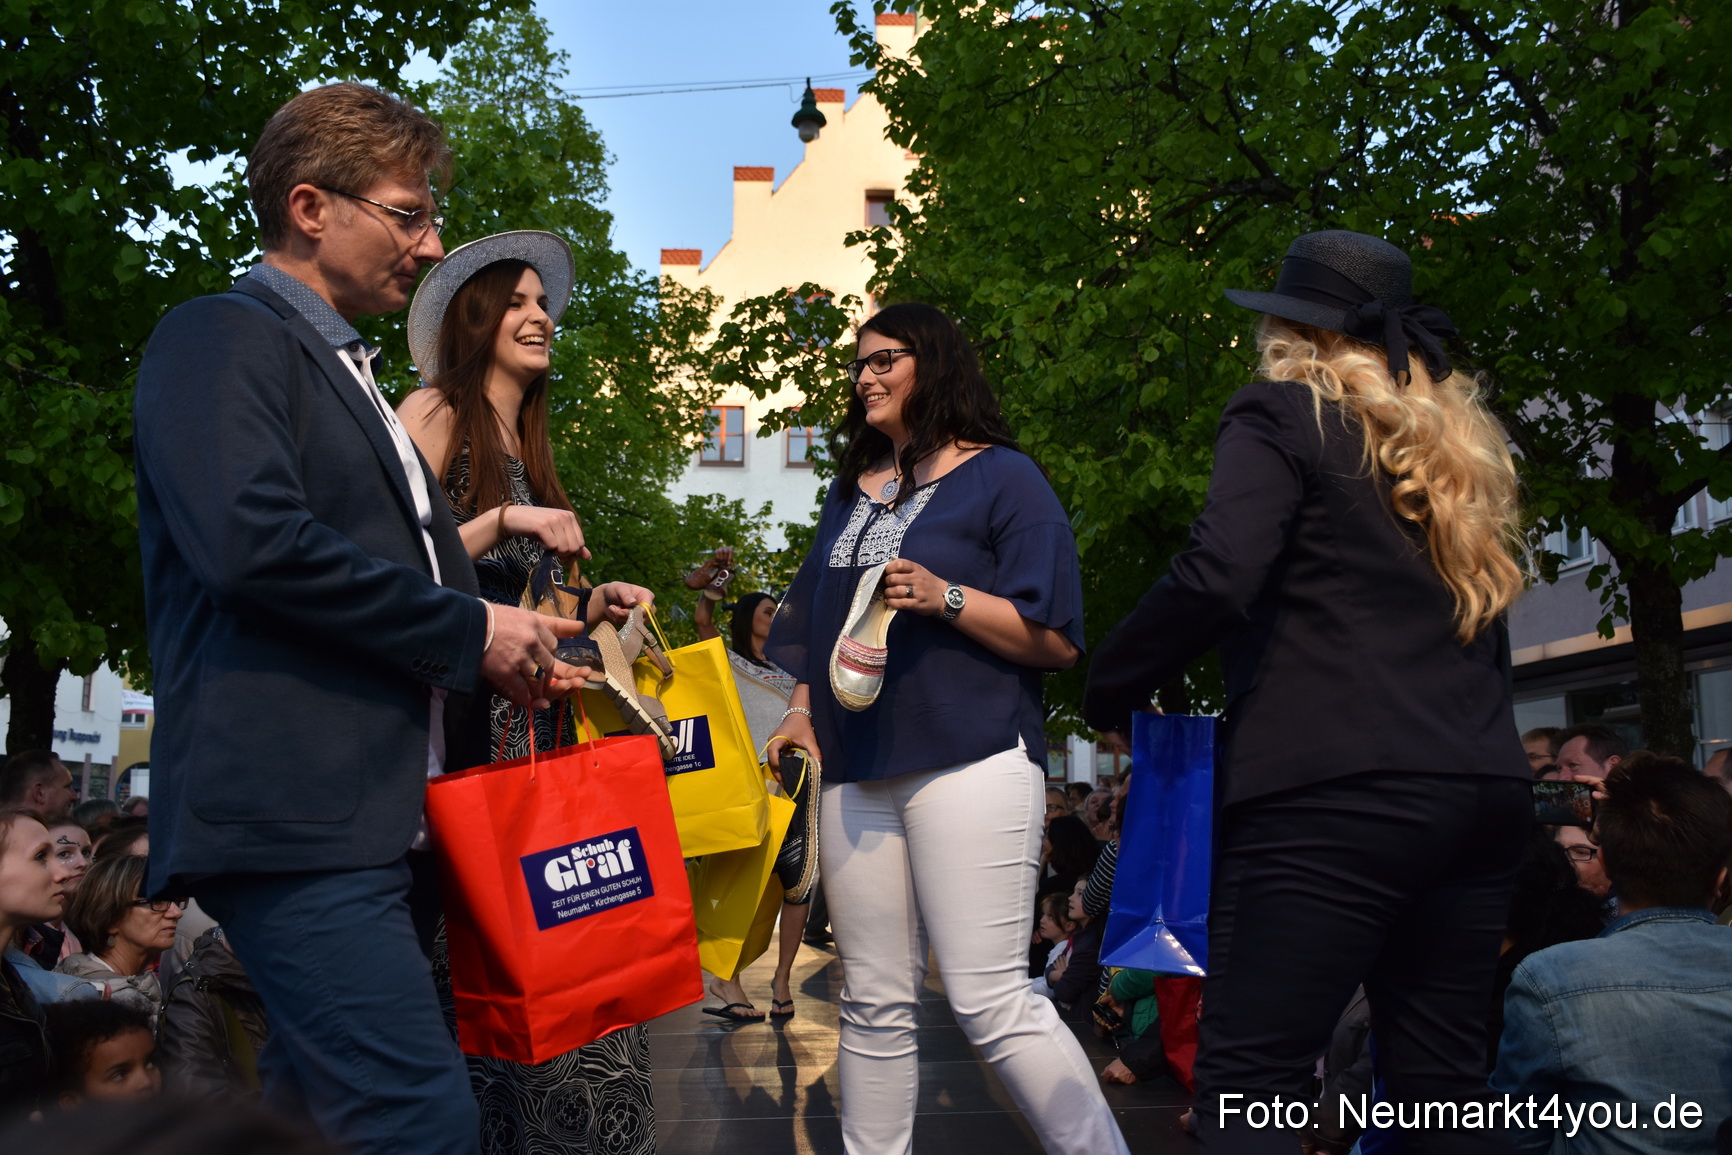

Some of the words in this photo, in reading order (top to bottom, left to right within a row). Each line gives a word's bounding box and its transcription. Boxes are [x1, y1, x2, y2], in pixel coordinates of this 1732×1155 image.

[544, 838, 635, 892] Graf
[570, 839, 615, 860] Schuh
[551, 898, 566, 909] ZEIT
[566, 894, 581, 904] FÜR
[581, 888, 601, 900] EINEN
[600, 883, 622, 894] GUTEN
[621, 875, 643, 888] SCHUH
[557, 902, 591, 919] Neumarkt
[594, 889, 637, 908] Kirchengasse
[636, 886, 642, 895] 5
